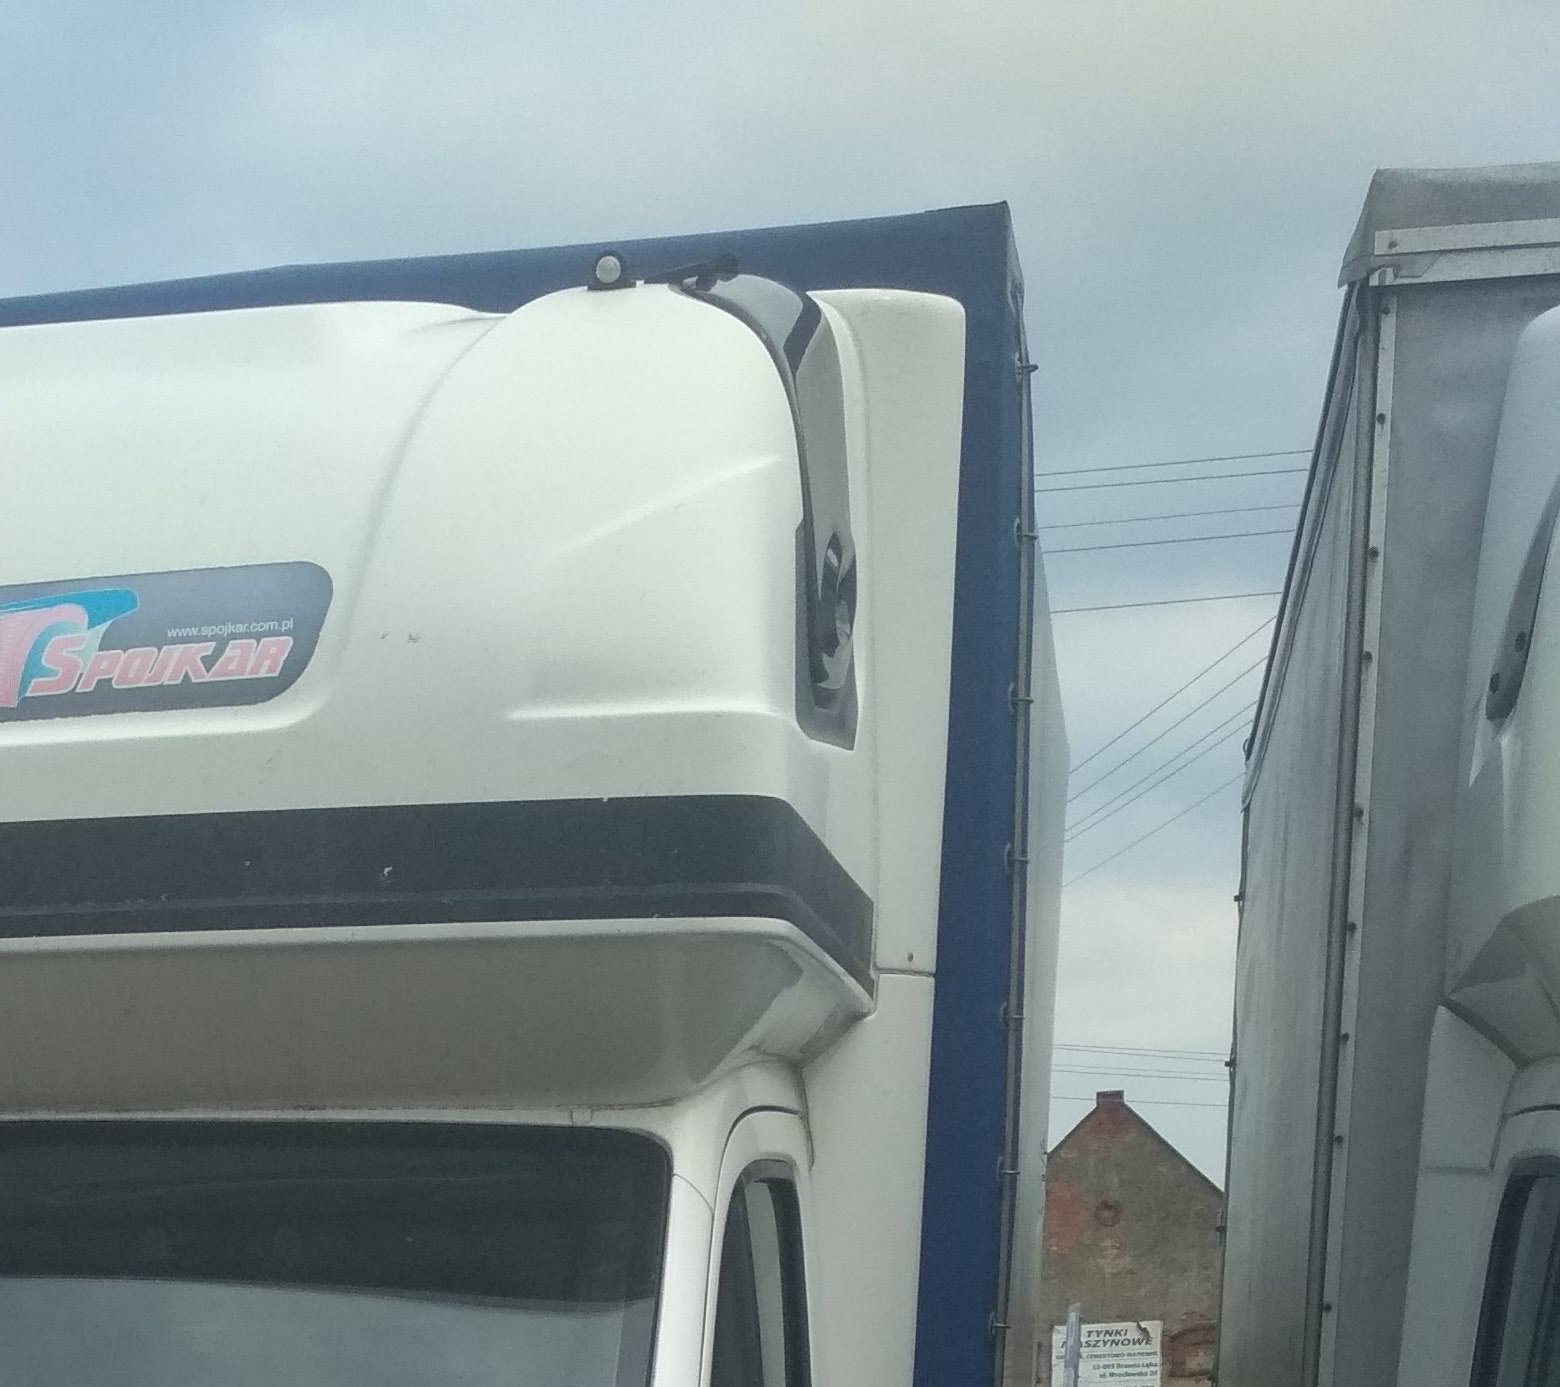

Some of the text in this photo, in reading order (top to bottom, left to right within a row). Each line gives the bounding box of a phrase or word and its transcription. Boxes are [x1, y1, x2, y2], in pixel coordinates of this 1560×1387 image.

[167, 618, 294, 638] www.spojkar.com.pl
[1086, 1329, 1128, 1338] TYNKI
[1061, 1336, 1153, 1349] SZYNOWE
